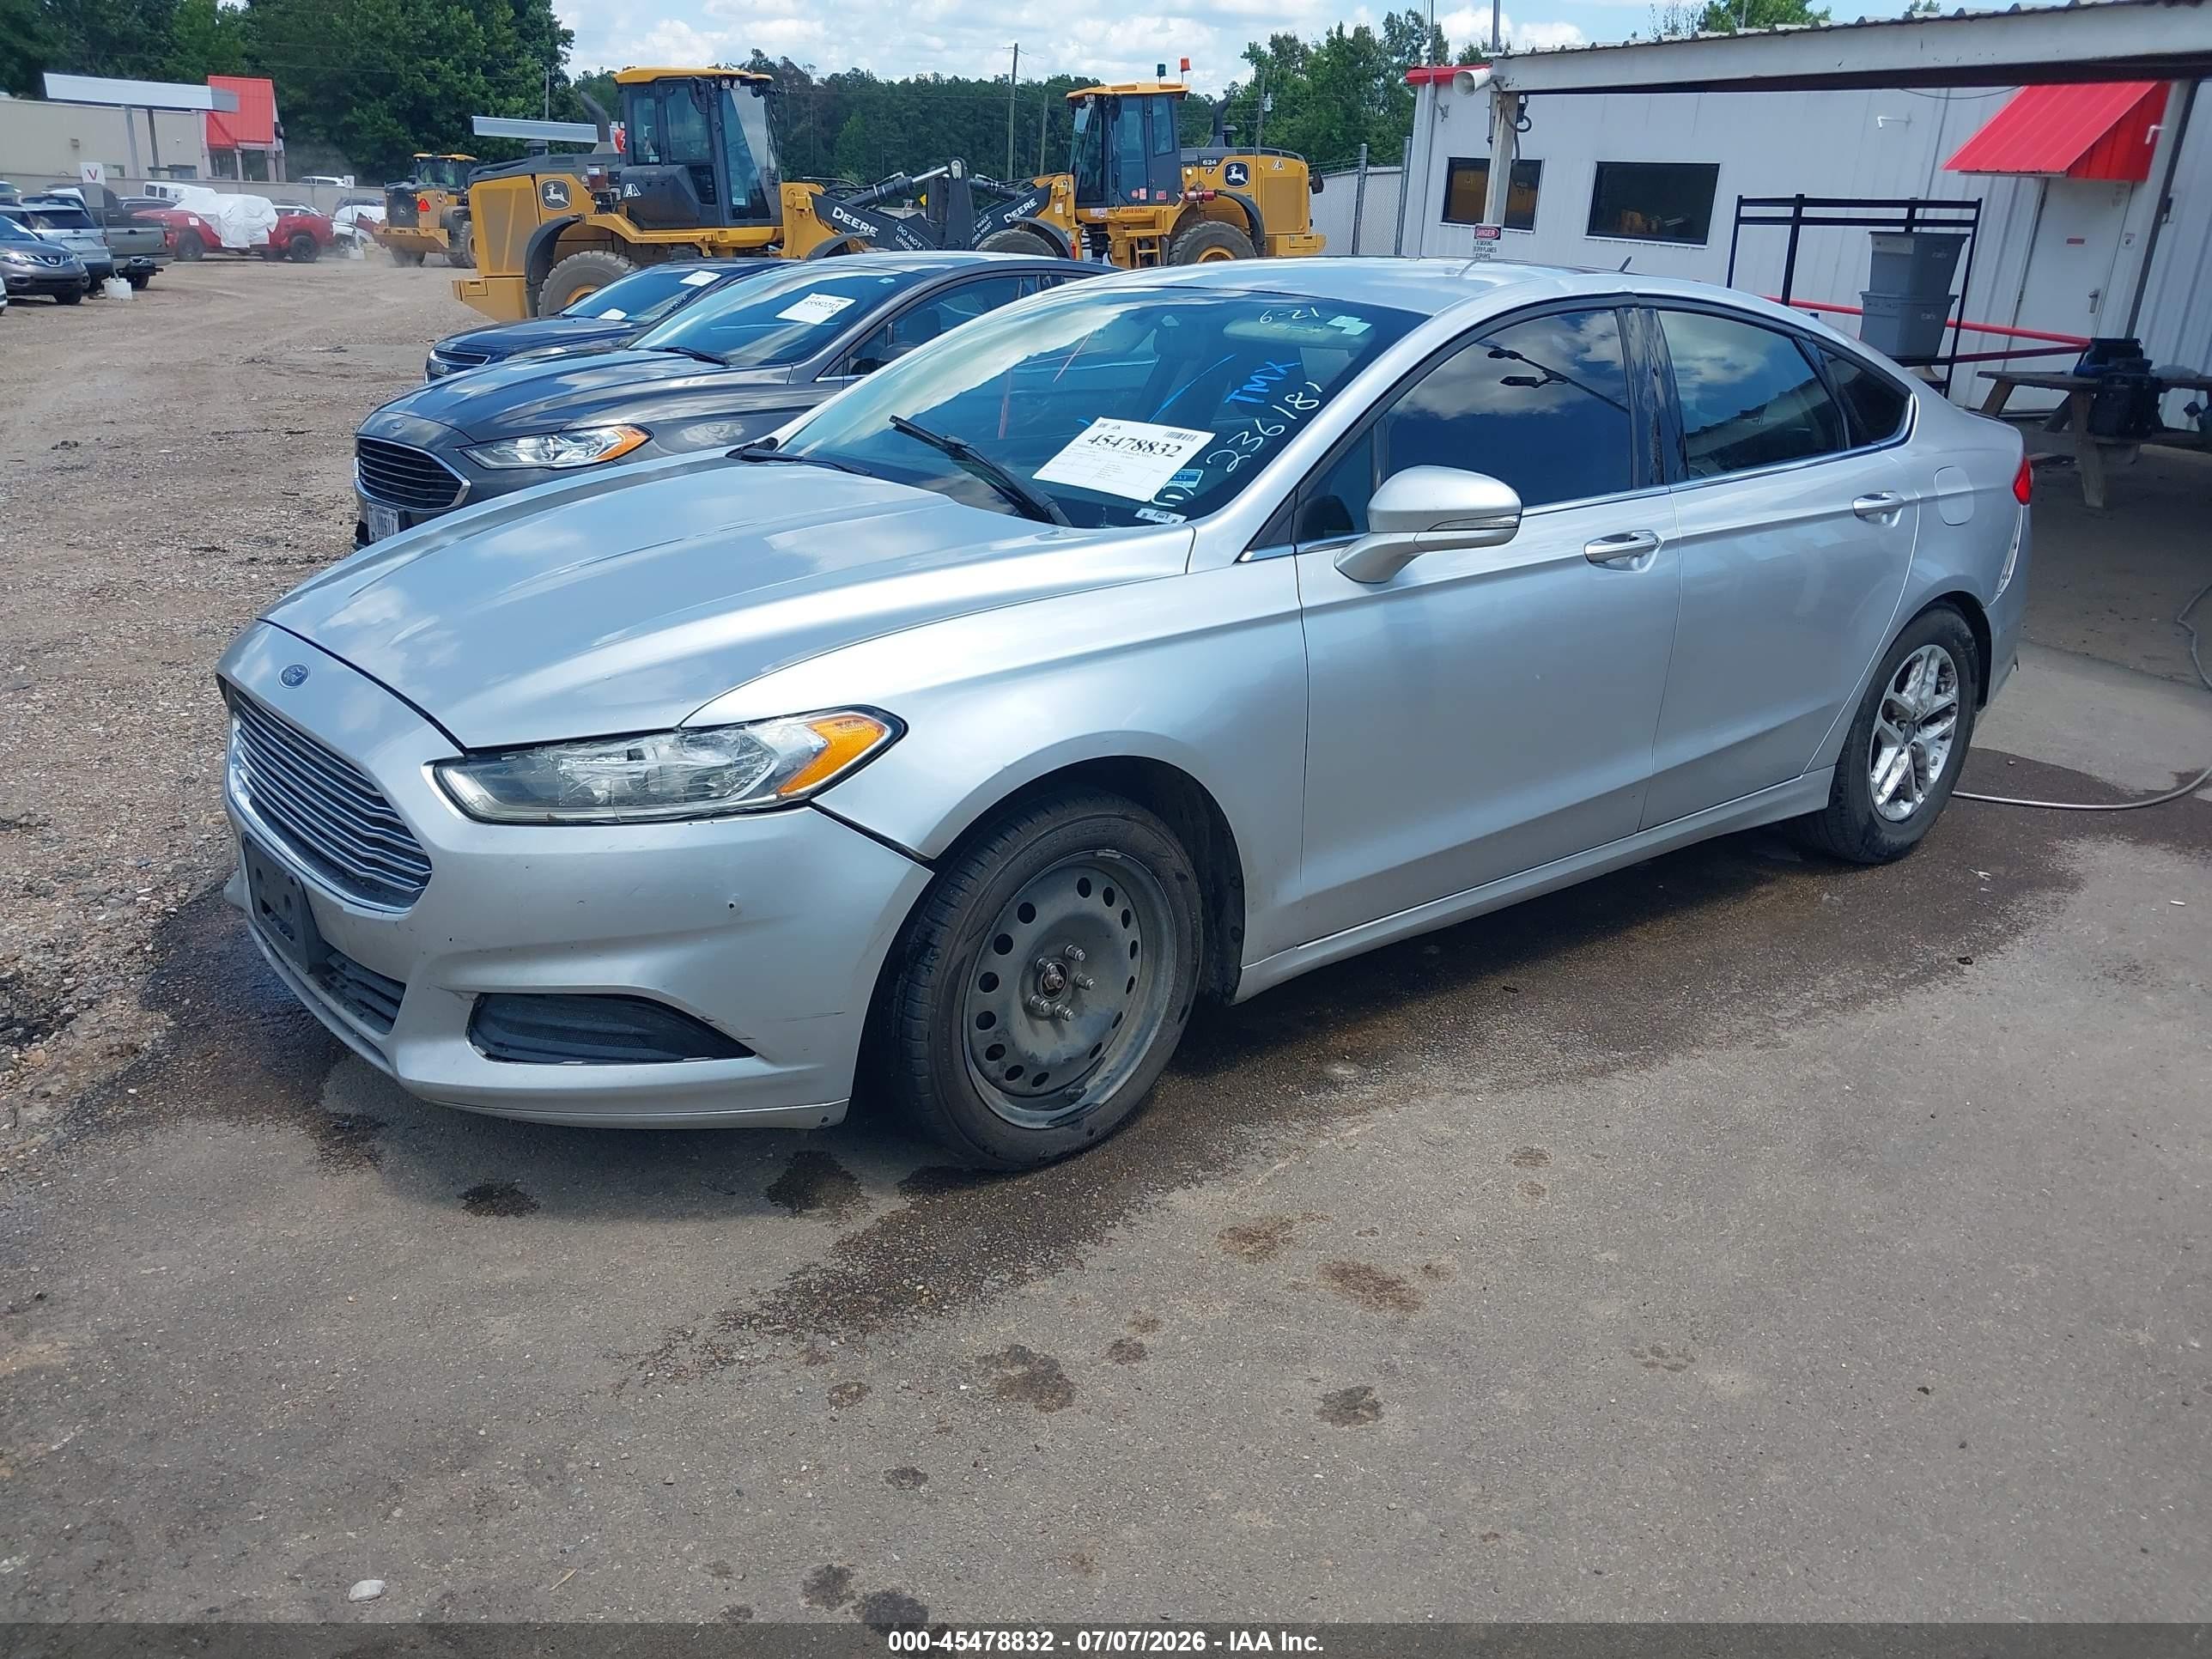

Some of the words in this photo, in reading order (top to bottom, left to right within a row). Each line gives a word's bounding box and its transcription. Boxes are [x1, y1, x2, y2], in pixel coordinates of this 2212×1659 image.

[87, 168, 98, 180] V
[831, 205, 879, 238] DEERE
[1002, 197, 1038, 224] DEERE
[896, 224, 908, 237] DO
[907, 234, 923, 249] NOT
[980, 220, 994, 236] MAST
[1260, 307, 1320, 324] 6-21
[1224, 361, 1302, 404] TMX
[1206, 381, 1322, 472] 236181
[1086, 434, 1183, 459] 45478832
